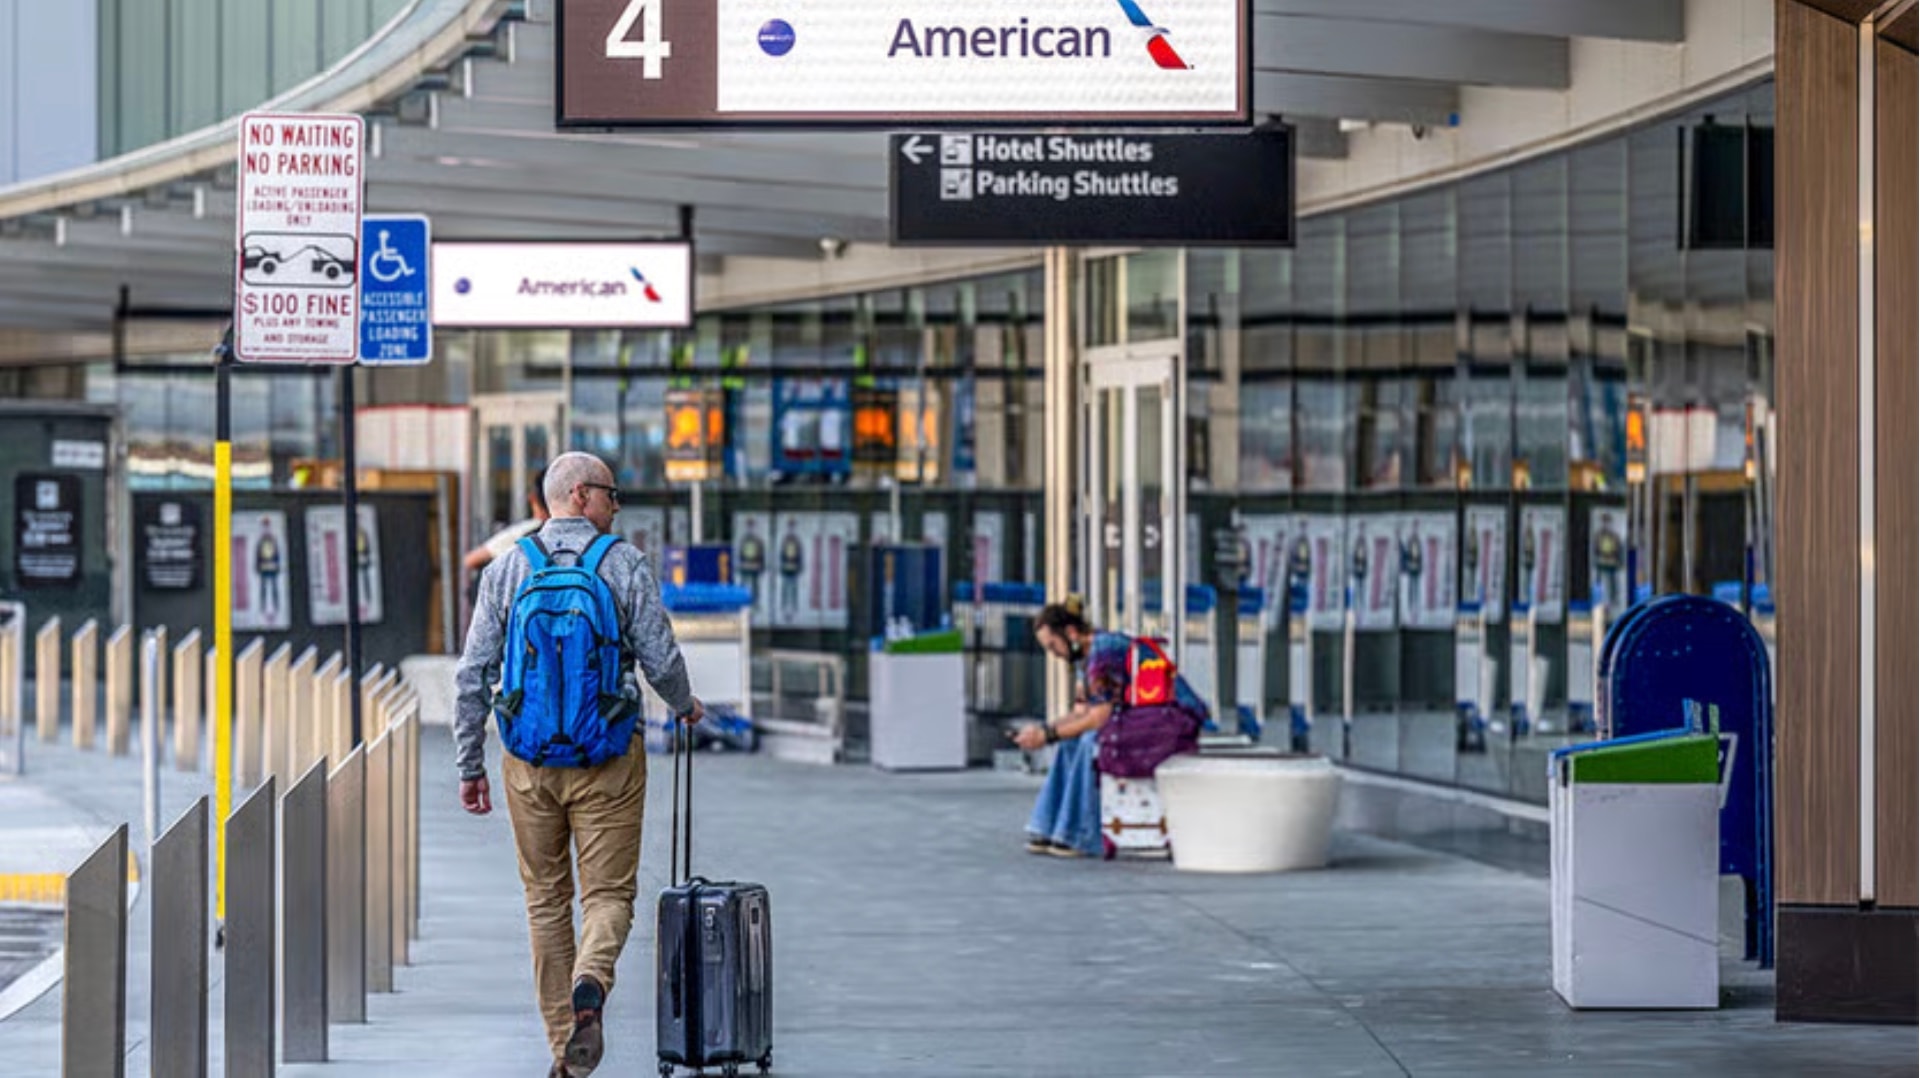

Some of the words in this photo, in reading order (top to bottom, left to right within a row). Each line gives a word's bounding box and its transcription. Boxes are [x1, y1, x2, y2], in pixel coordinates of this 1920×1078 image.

[606, 0, 671, 79] 4
[887, 18, 1110, 57] American
[250, 125, 274, 146] NO
[281, 125, 354, 148] WAITING
[976, 136, 1045, 161] Hotel
[1049, 137, 1153, 162] Shuttles
[247, 154, 269, 175] NO
[277, 154, 354, 177] PARKING
[254, 186, 287, 198] ACTIVE
[291, 187, 348, 198] PASSENGER
[976, 170, 1070, 200] Parking
[1073, 170, 1178, 196] Shuttles
[287, 214, 311, 226] ONLY
[517, 277, 627, 296] American
[243, 293, 298, 315] $100
[307, 294, 352, 316] FINE
[364, 292, 424, 307] ACCESSIBLE
[254, 317, 279, 328] PLUS
[283, 318, 301, 327] ANY
[305, 318, 340, 329] TOWING
[361, 308, 427, 323] PASSENGER
[264, 334, 284, 344] AND
[287, 334, 328, 345] STORAGE
[369, 327, 419, 341] LOADING
[380, 343, 408, 358] ZONE
